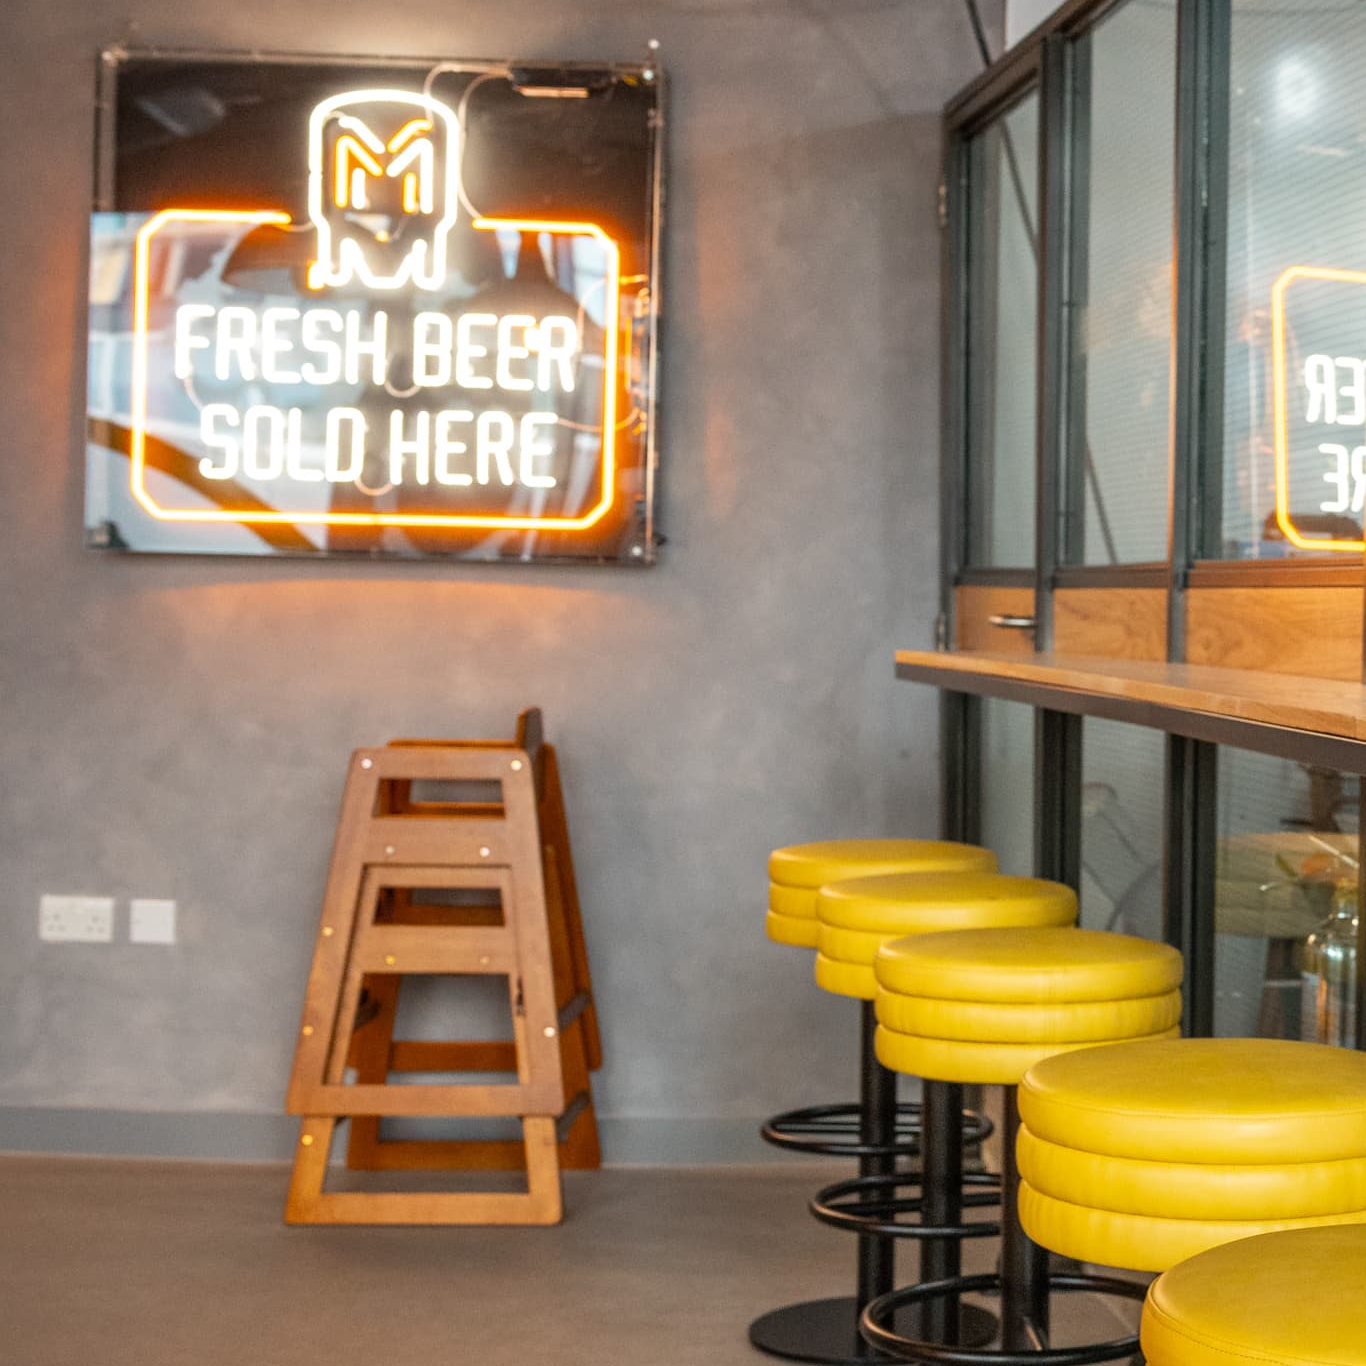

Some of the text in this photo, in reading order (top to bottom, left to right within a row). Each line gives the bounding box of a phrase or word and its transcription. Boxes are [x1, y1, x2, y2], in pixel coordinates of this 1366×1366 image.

[172, 302, 579, 393] FRESH BEER
[198, 401, 560, 488] SOLD HERE
